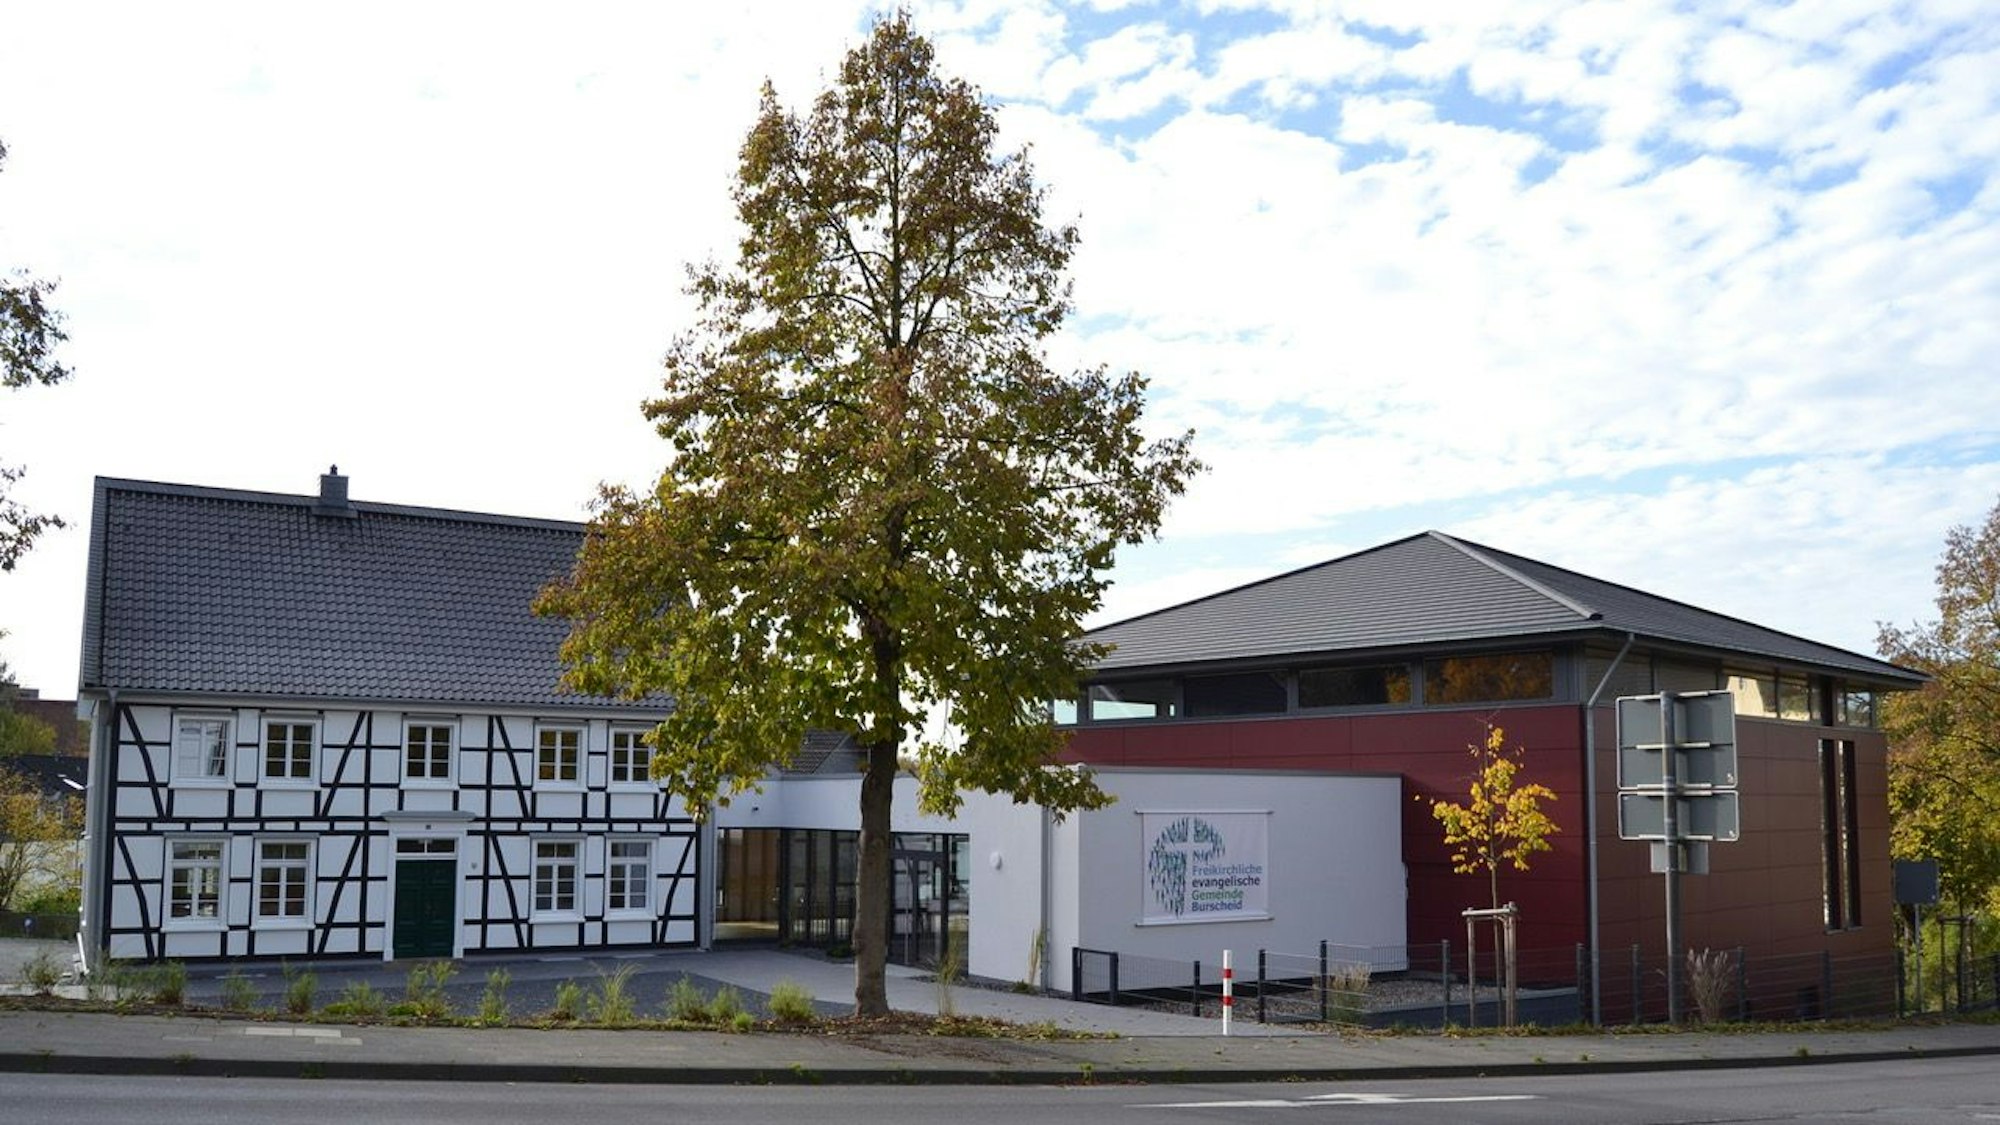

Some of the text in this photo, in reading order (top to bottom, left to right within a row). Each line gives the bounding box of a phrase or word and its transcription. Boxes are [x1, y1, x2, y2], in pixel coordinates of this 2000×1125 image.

[1192, 864, 1262, 876] Freikirchliche
[1192, 876, 1260, 889] evangelische
[1192, 889, 1244, 900] Gemeinde
[1191, 901, 1242, 912] Burscheid
